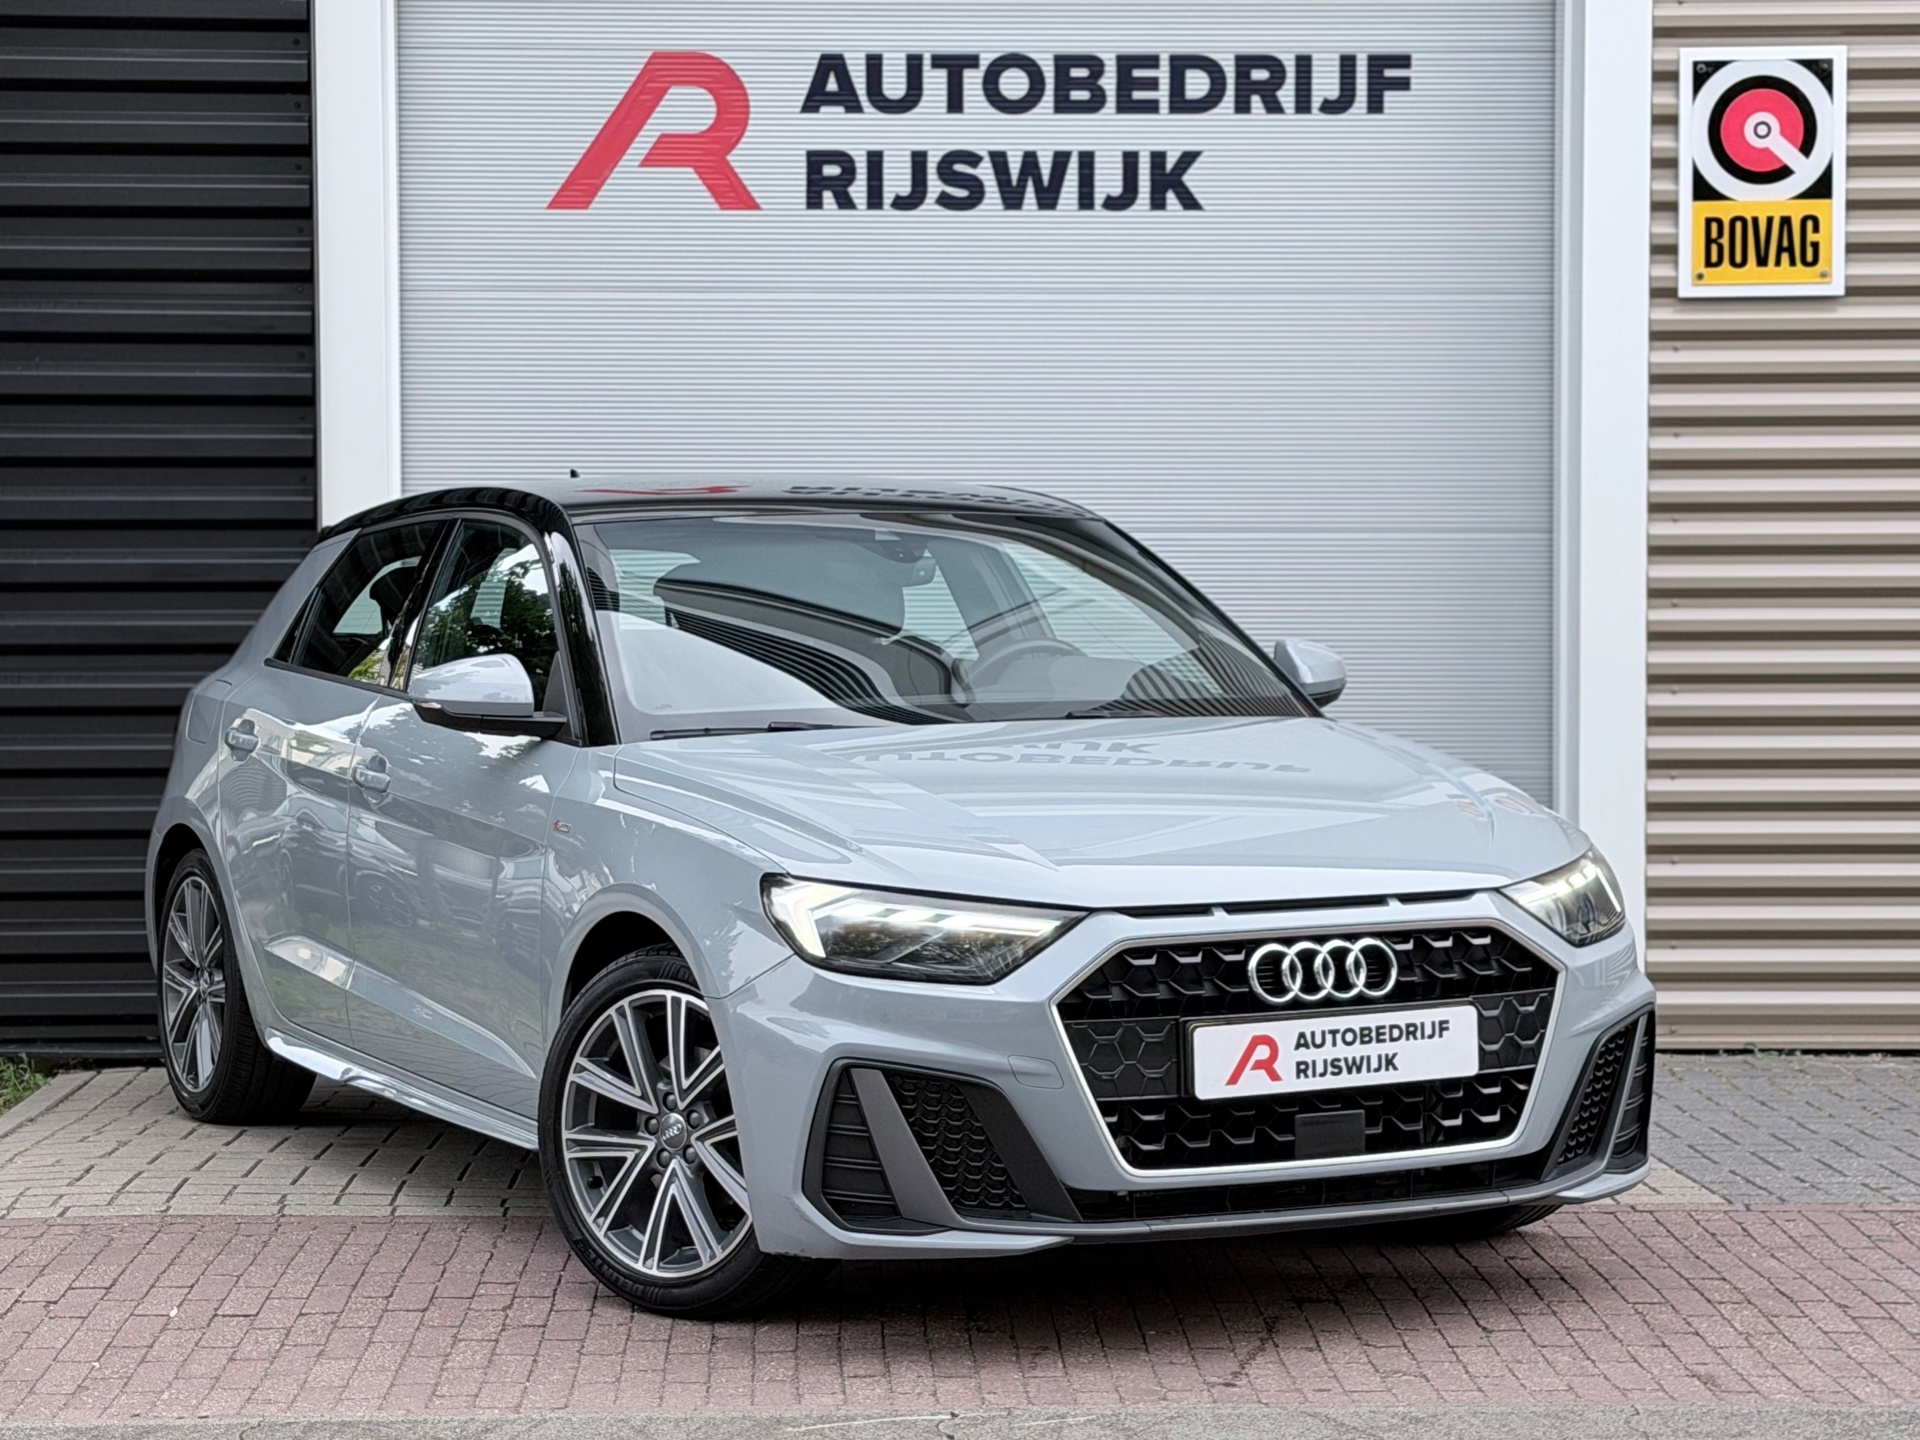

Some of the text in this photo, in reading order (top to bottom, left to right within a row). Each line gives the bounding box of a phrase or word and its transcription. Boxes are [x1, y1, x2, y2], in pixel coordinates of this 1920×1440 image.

[800, 53, 1412, 115] AUTOBEDRIJF
[805, 150, 1204, 212] RIJSWIJK
[1703, 214, 1821, 270] BOVAG
[1293, 1019, 1451, 1051] AUTOBEDRIJF
[1295, 1052, 1399, 1080] RIJSWIJK
